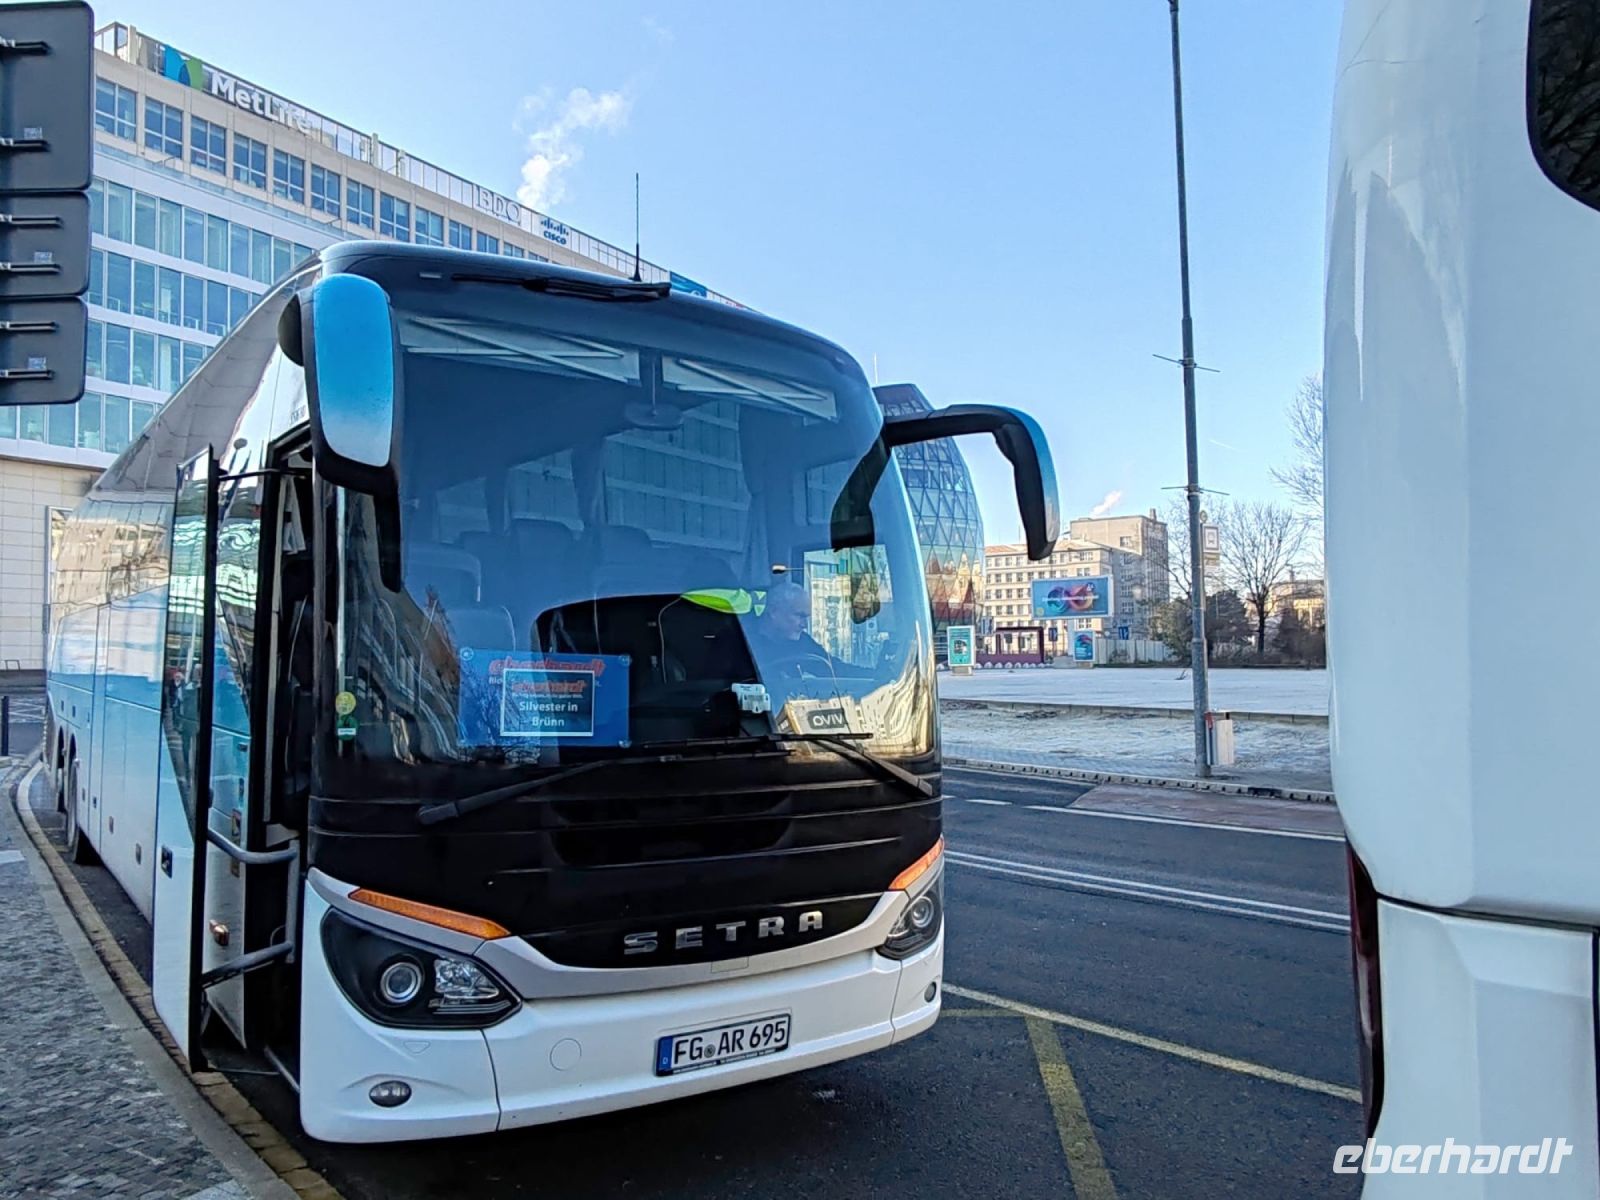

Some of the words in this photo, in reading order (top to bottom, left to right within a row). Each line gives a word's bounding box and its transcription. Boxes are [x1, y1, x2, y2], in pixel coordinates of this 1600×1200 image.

[211, 70, 311, 135] MetLife
[475, 185, 521, 226] BDO
[519, 701, 566, 712] Silvester
[568, 701, 578, 712] in
[532, 716, 565, 727] Brünn
[623, 910, 823, 955] SETRA
[674, 1036, 703, 1065] FG
[717, 1029, 745, 1055] AR
[749, 1020, 786, 1049] 695
